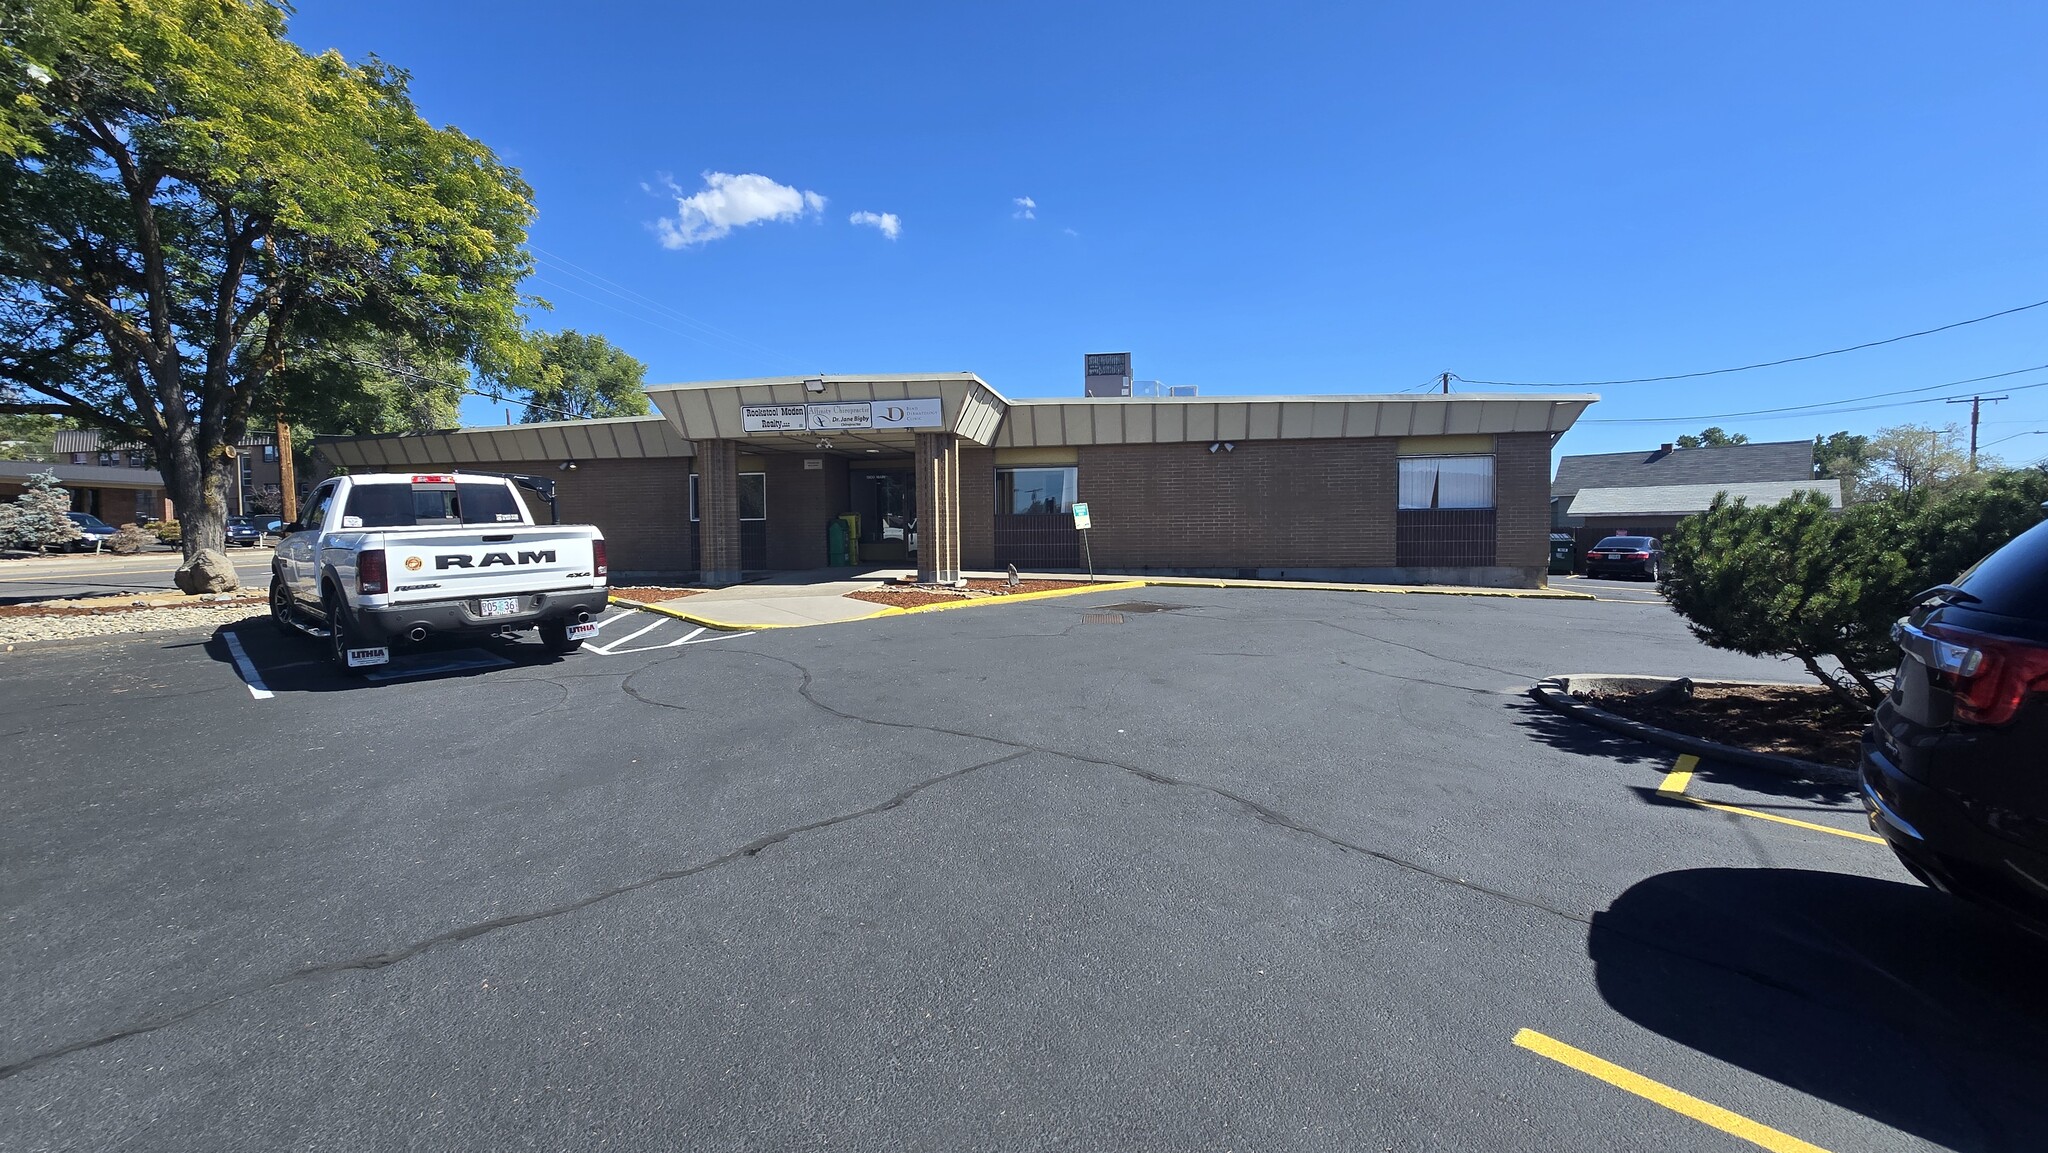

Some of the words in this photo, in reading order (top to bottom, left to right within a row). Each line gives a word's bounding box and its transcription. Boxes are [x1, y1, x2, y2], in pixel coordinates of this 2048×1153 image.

[808, 407, 831, 415] Affinity
[761, 419, 782, 429] Realty
[434, 550, 557, 570] RAM
[569, 624, 596, 634] LITHIA
[352, 649, 385, 659] LITHIA
